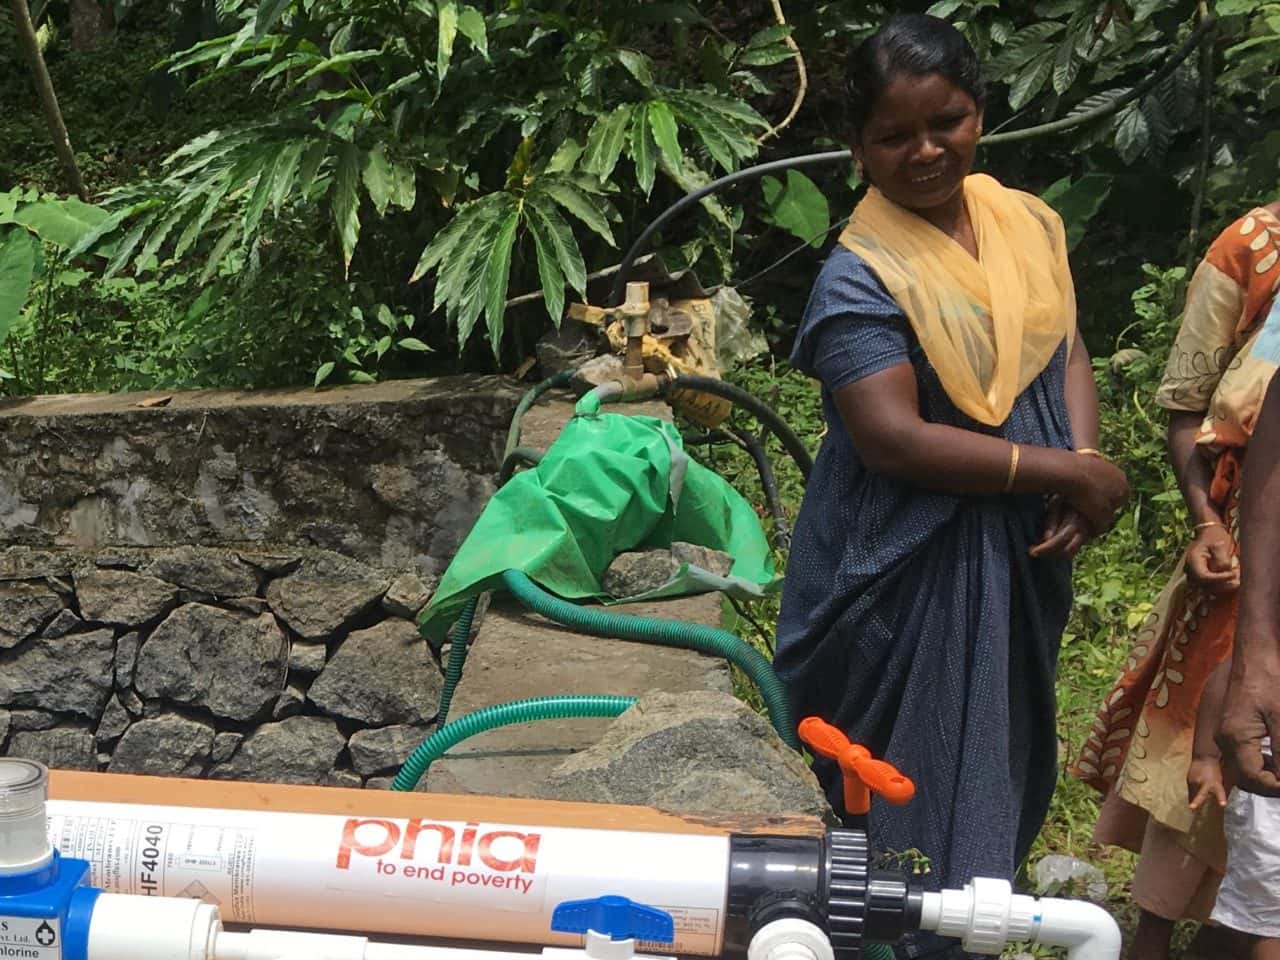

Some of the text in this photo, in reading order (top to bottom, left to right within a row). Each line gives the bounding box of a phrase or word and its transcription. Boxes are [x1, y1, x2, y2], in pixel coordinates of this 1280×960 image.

[336, 818, 541, 874] phia
[376, 859, 533, 894] to end poverty
